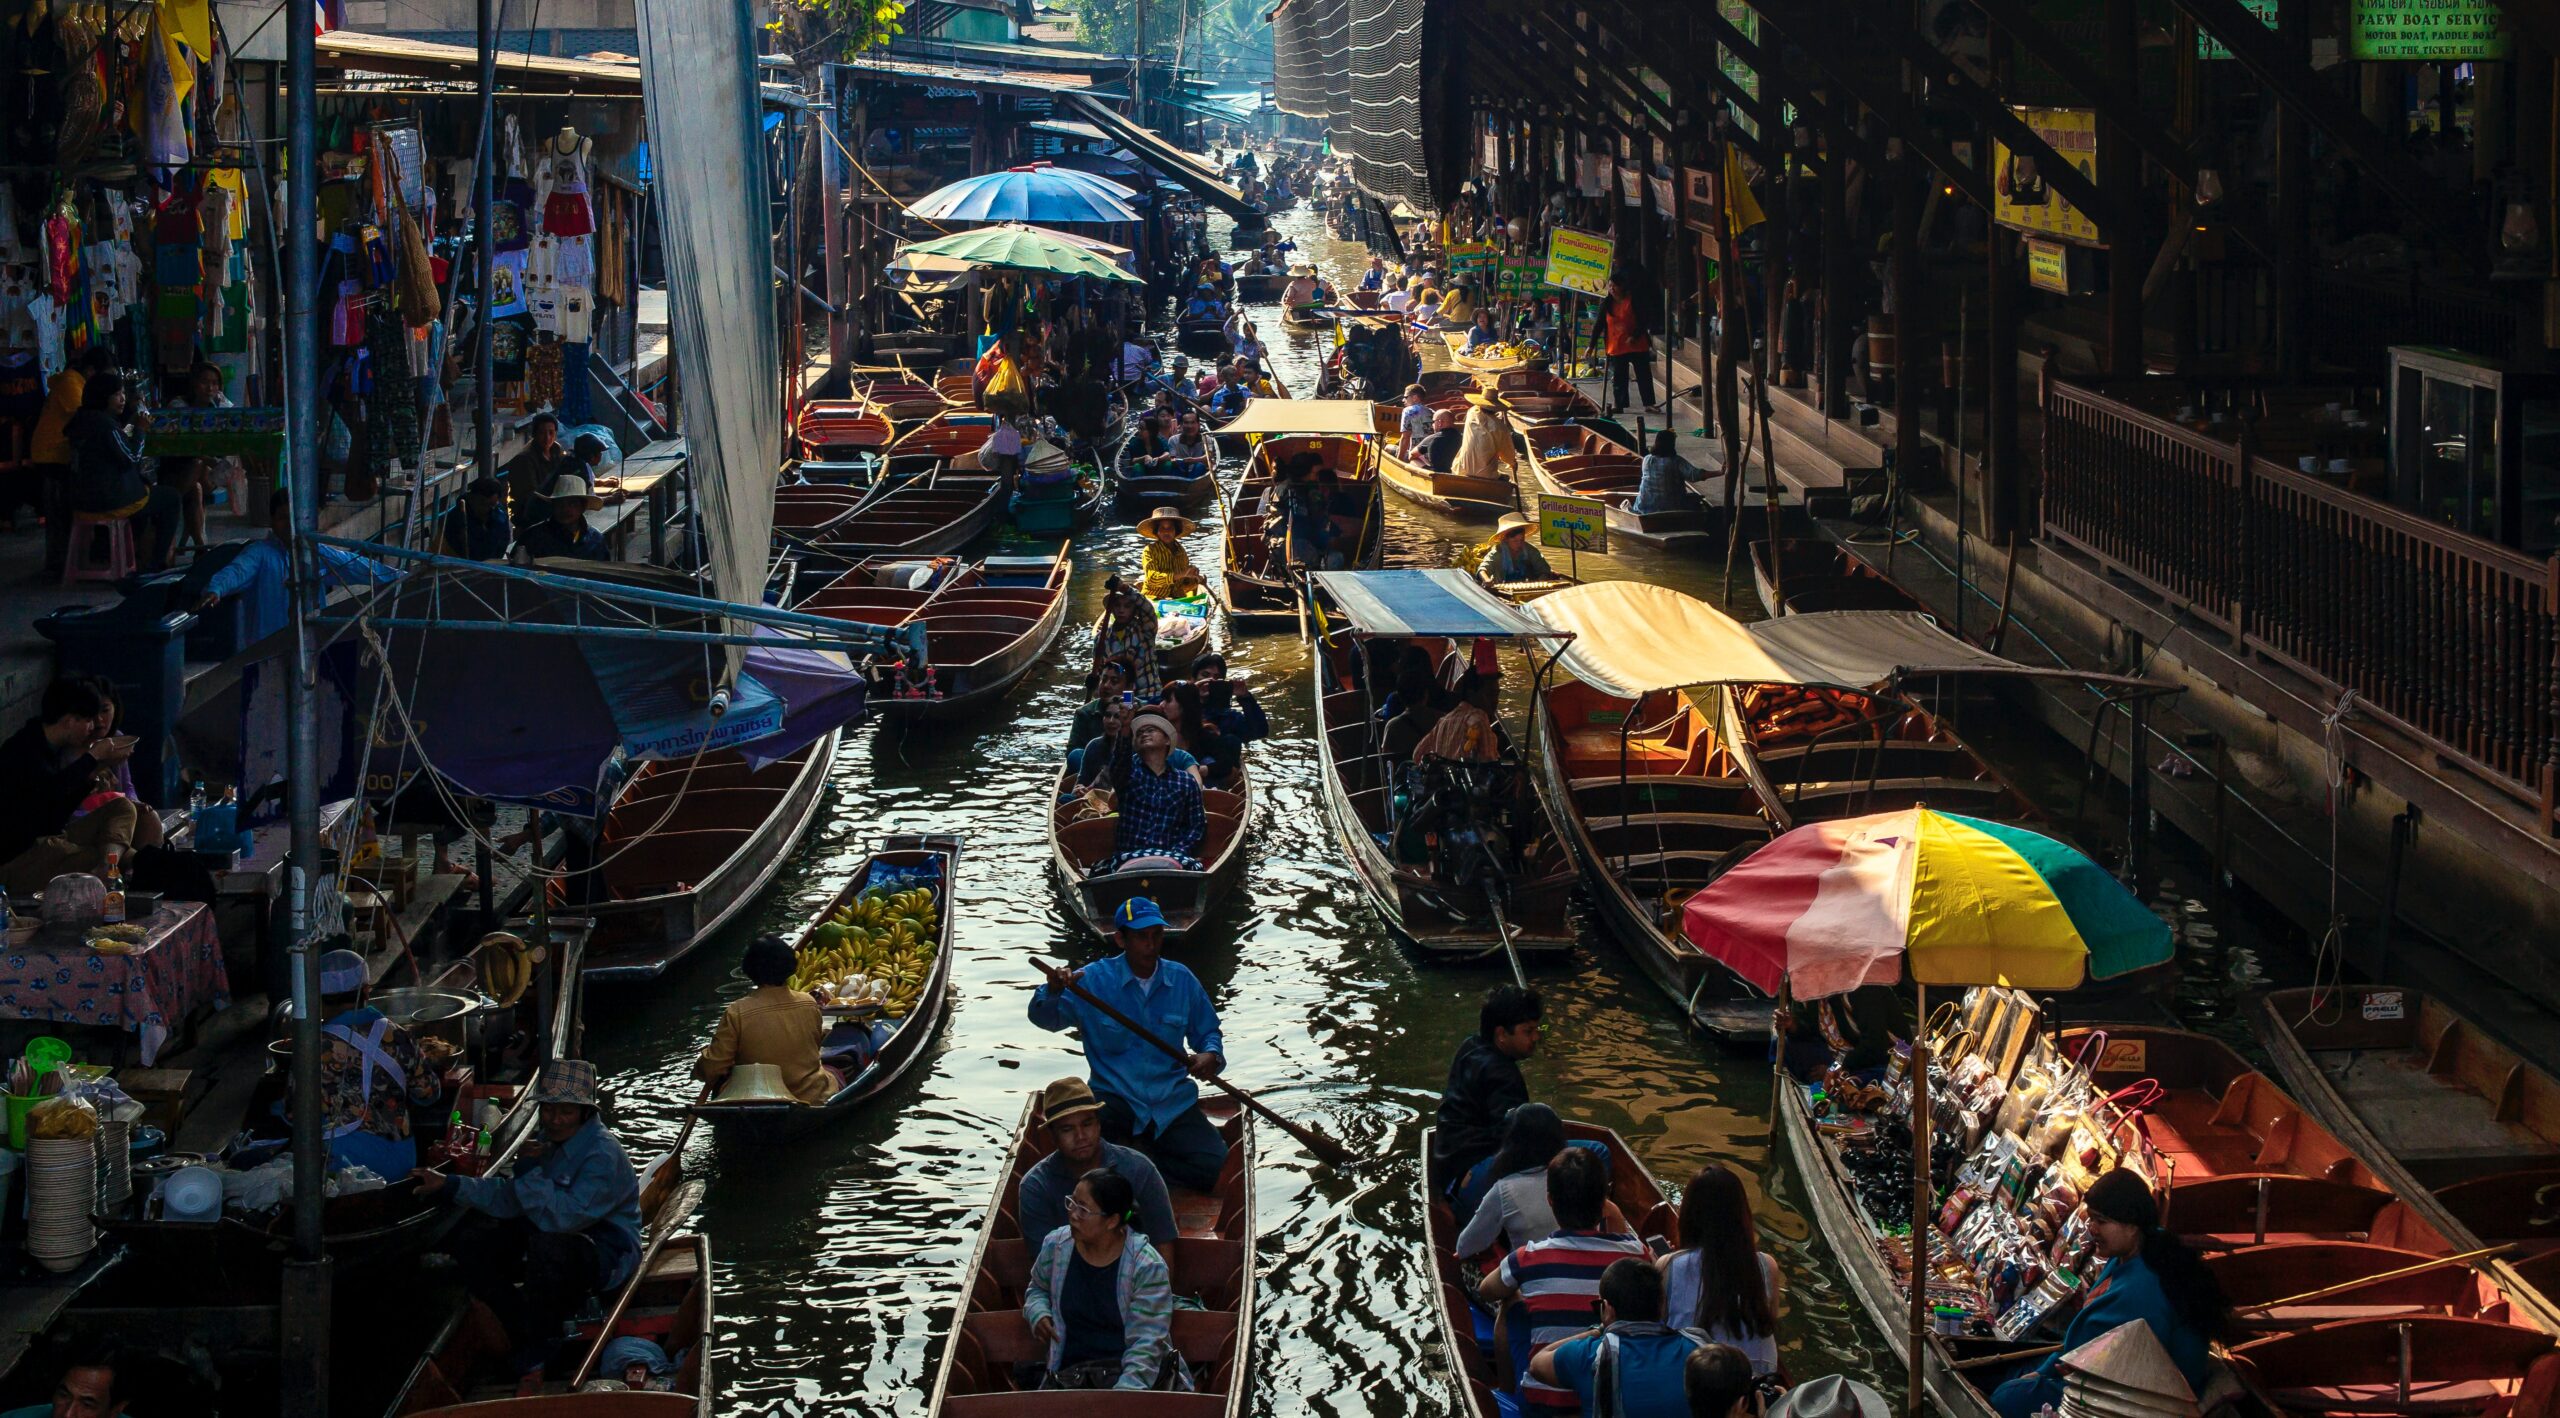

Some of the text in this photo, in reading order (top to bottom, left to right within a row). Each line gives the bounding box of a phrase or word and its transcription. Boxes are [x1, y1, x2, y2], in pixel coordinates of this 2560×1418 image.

[2357, 14, 2398, 26] PAEW
[2403, 14, 2441, 26] BOAT
[2365, 31, 2397, 40] MOTOR
[2432, 31, 2469, 40] PADDLE
[2378, 46, 2485, 55] BUY THE TICKET HERE
[1541, 501, 1603, 517] Grilled Bananas
